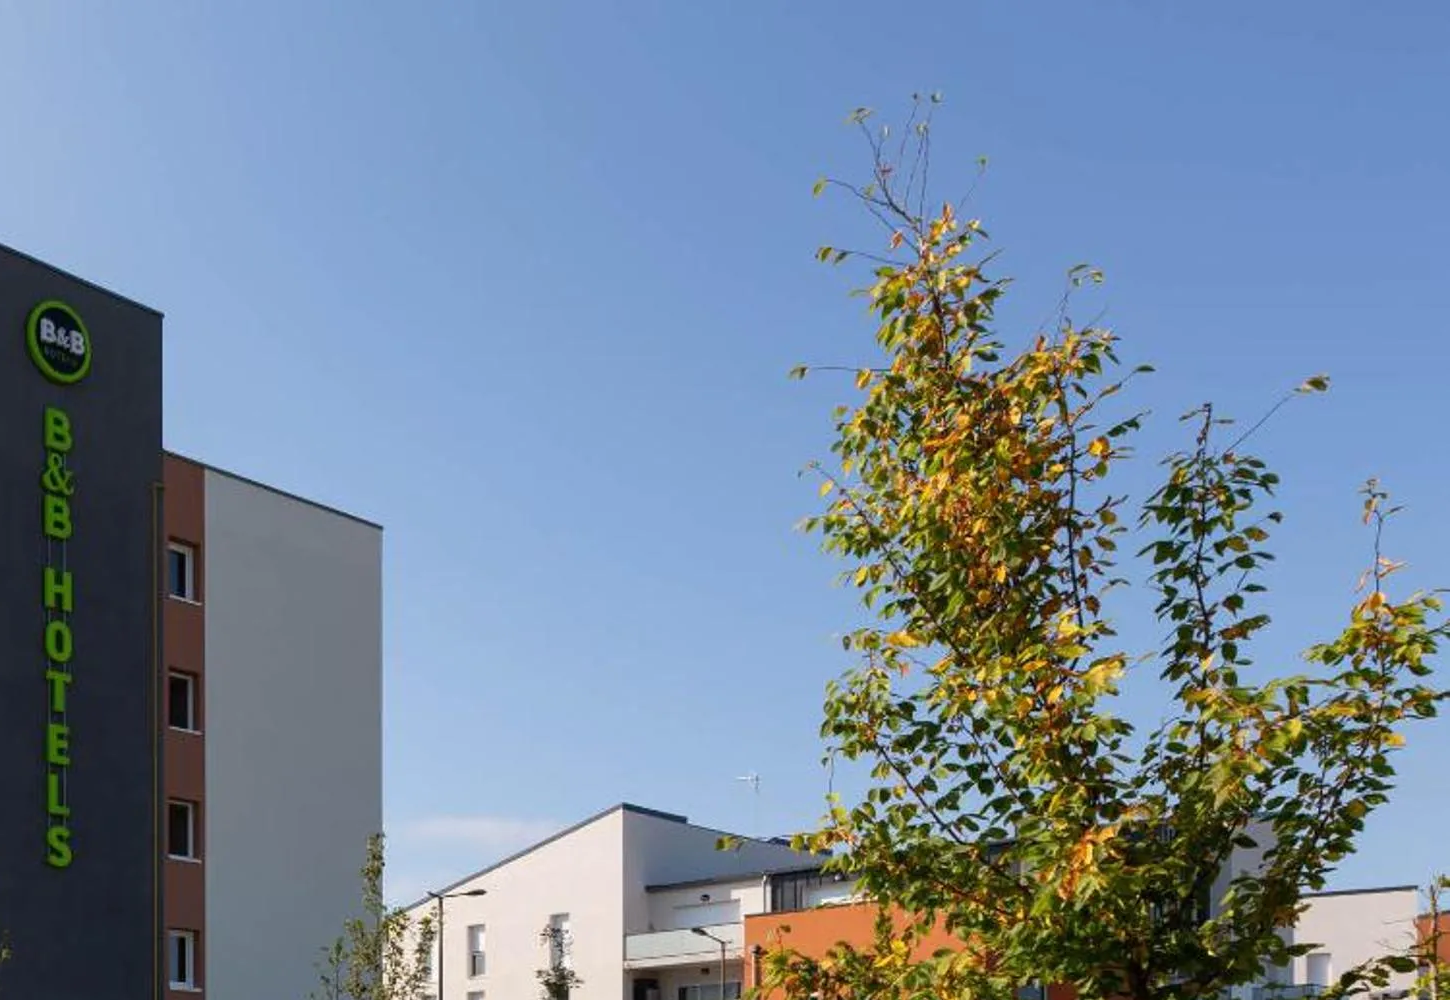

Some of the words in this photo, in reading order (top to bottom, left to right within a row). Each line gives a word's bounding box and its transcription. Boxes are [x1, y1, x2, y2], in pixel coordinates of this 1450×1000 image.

[40, 317, 85, 355] B&B
[43, 407, 74, 540] B&B
[44, 567, 73, 868] HOTELS
